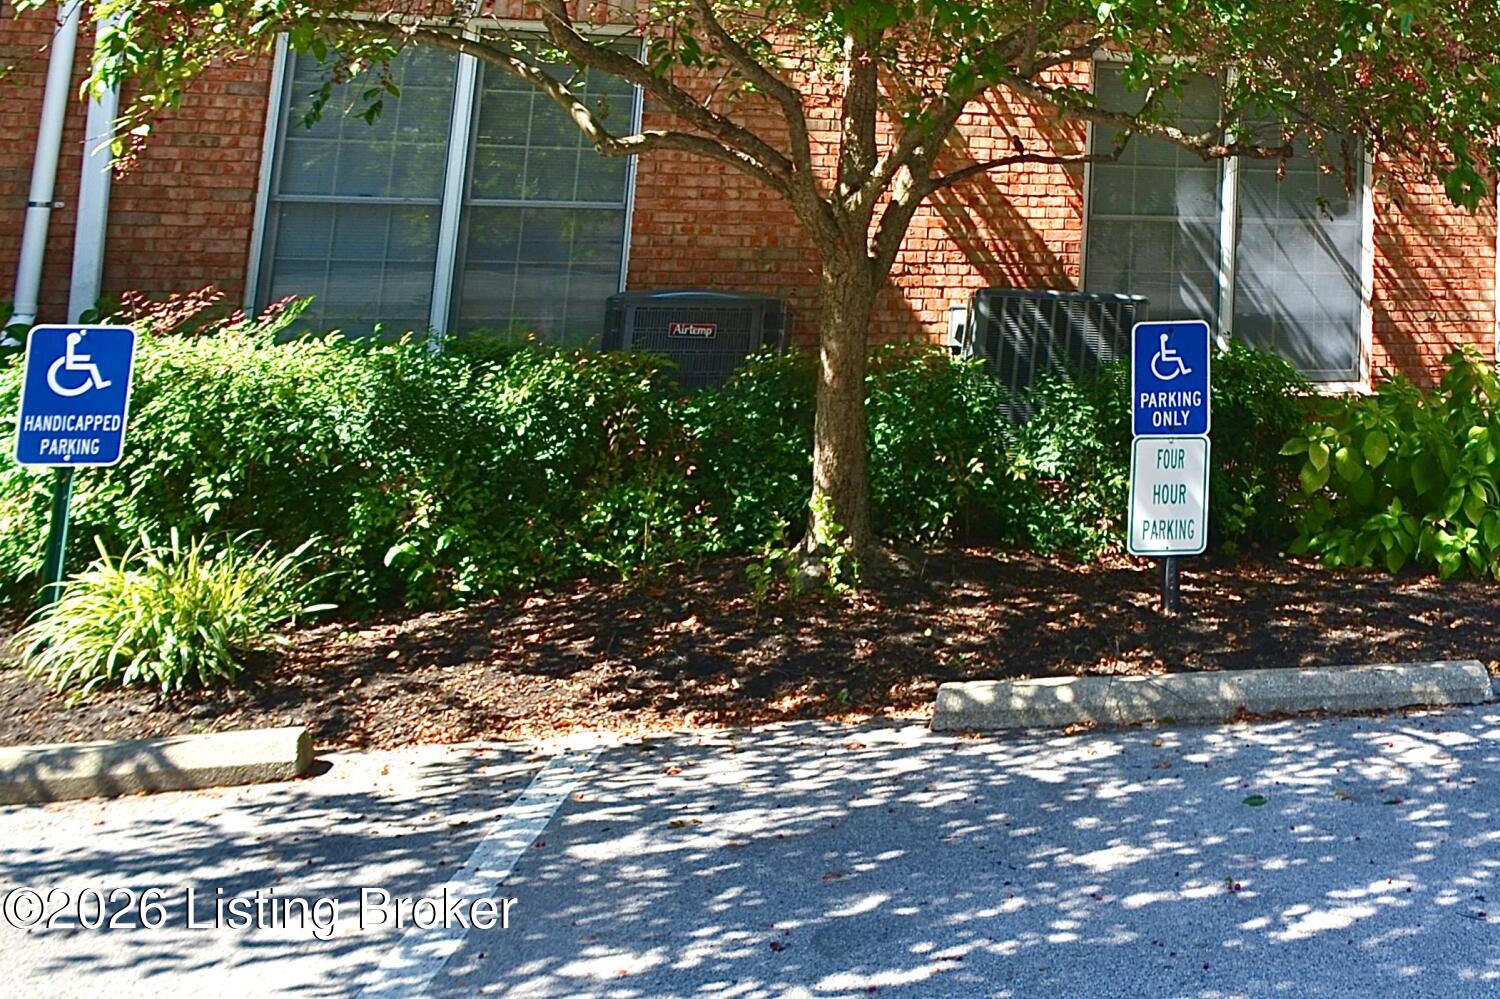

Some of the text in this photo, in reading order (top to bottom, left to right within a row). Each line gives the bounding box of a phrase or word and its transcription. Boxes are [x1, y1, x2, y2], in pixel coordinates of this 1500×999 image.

[672, 324, 713, 337] Airtemp
[1140, 391, 1202, 408] PARKING
[24, 415, 121, 431] HANDICAPPED
[1152, 410, 1190, 427] ONLY
[39, 438, 100, 455] PARKING
[1157, 448, 1185, 469] FOUR
[1153, 484, 1186, 504] HOUR
[1142, 519, 1195, 541] PARKING
